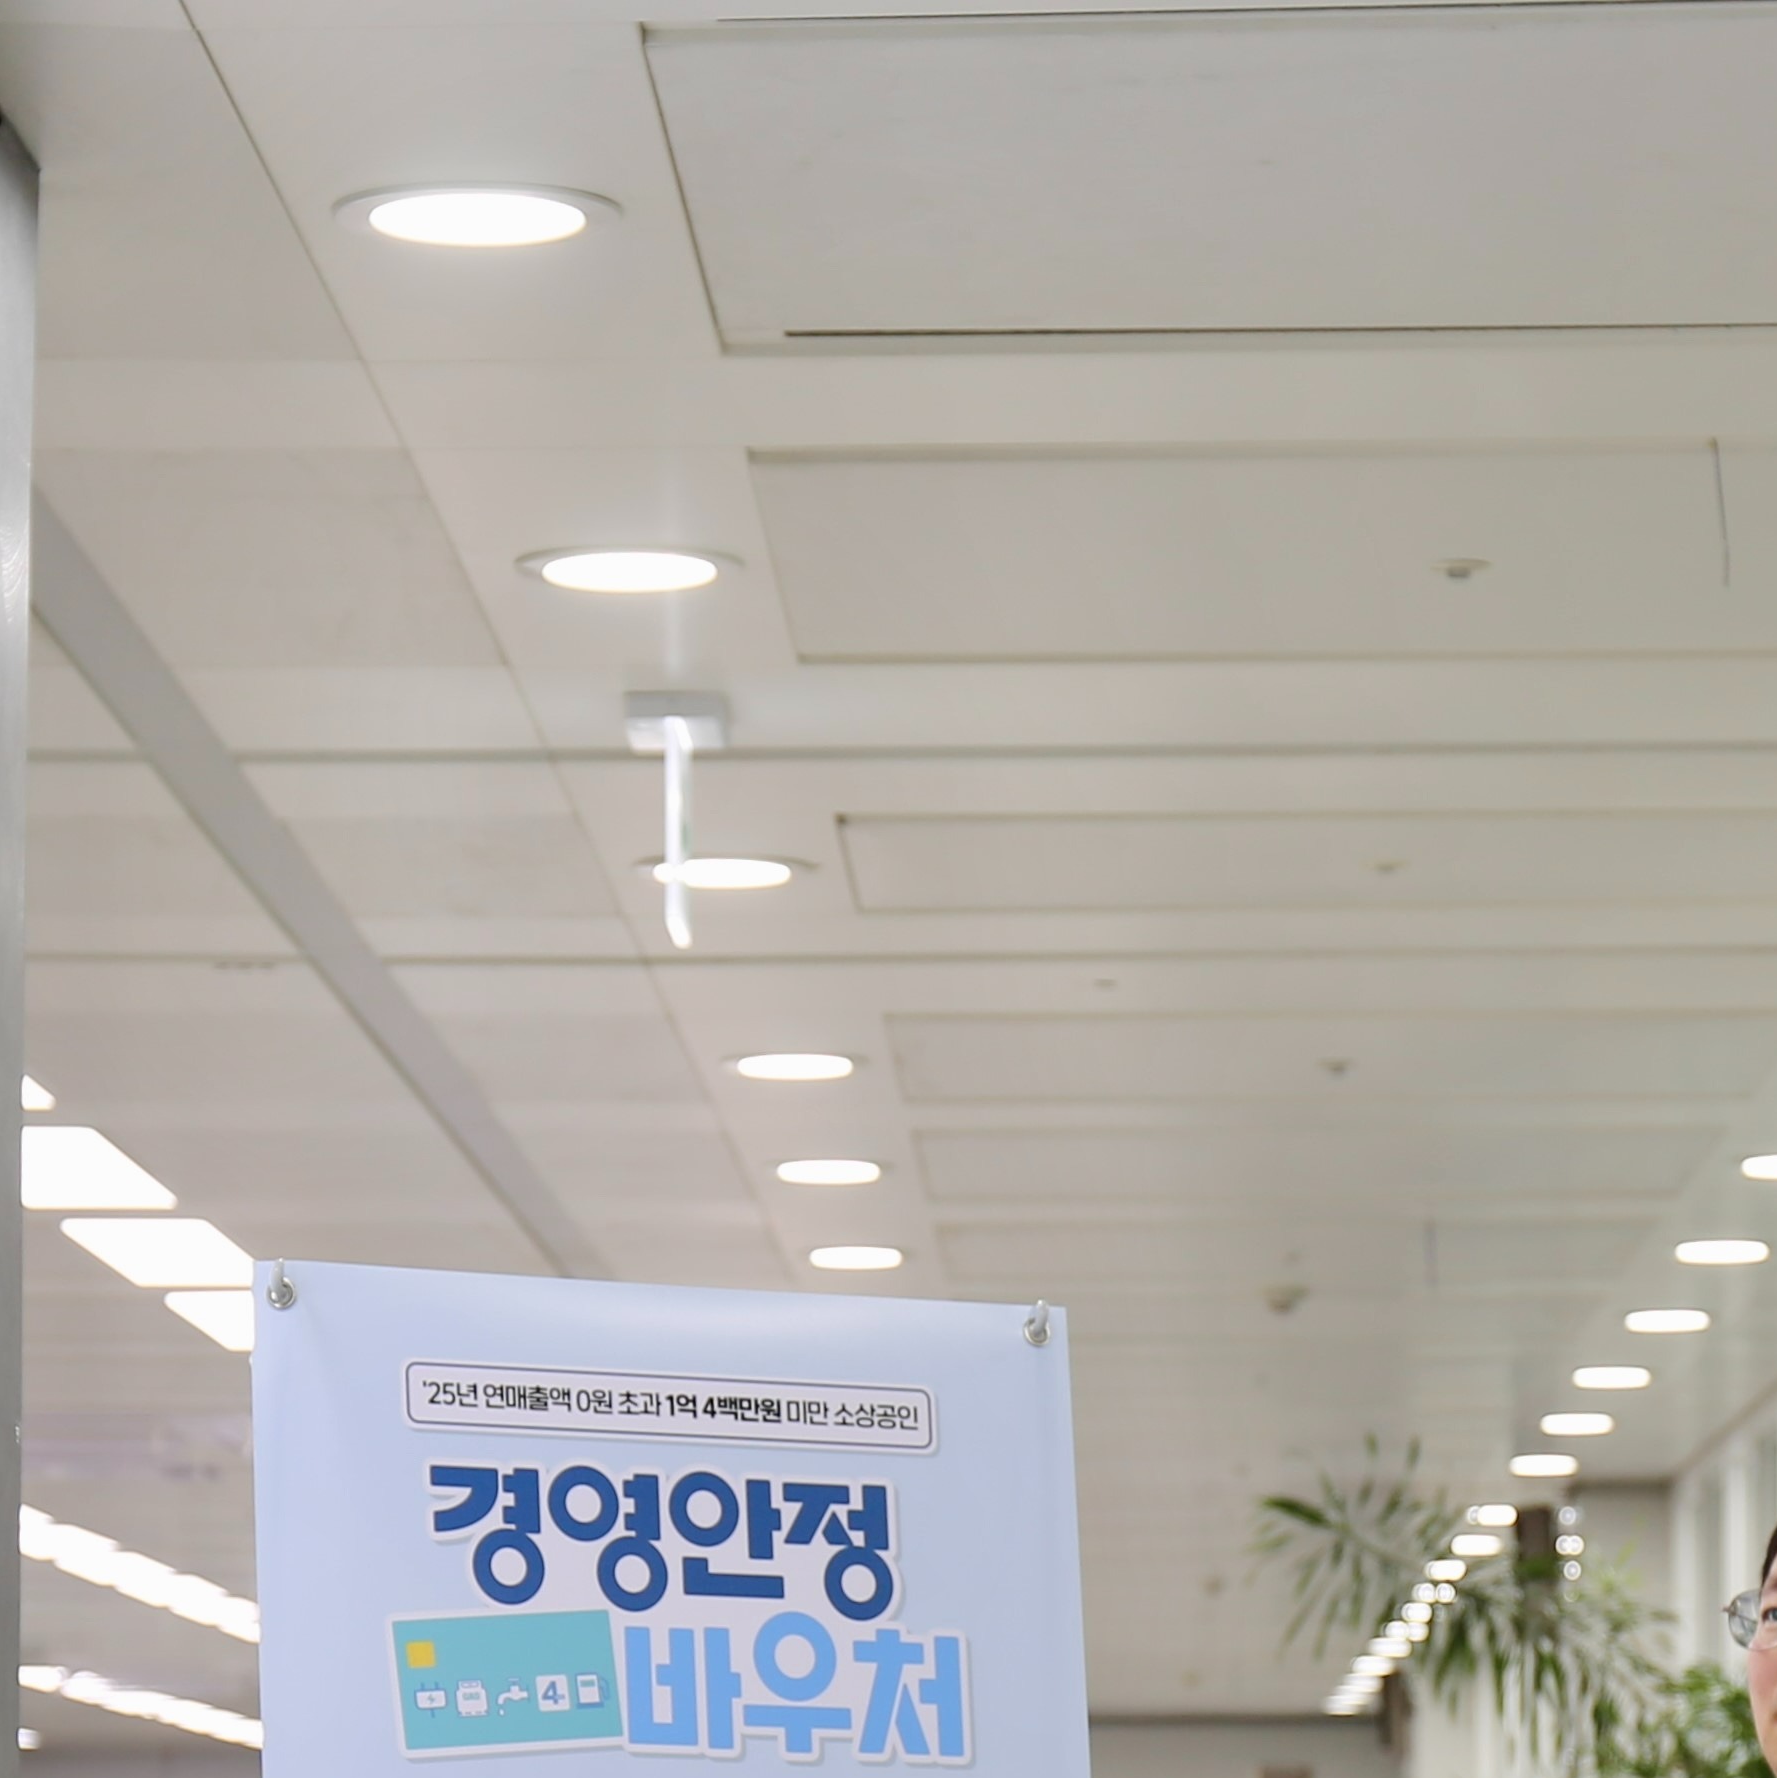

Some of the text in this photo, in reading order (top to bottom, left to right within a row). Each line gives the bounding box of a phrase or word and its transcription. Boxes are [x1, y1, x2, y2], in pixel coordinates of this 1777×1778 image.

[483, 1384, 571, 1413] 연매출액
[577, 1389, 613, 1415] 0원
[619, 1391, 659, 1417] 초과
[666, 1394, 697, 1419] 1억
[703, 1397, 781, 1424] 4백만원
[787, 1400, 828, 1425] 미만
[834, 1403, 919, 1430] 소상공인
[429, 1464, 894, 1621] 경영안정
[624, 1612, 964, 1757] 바우처
